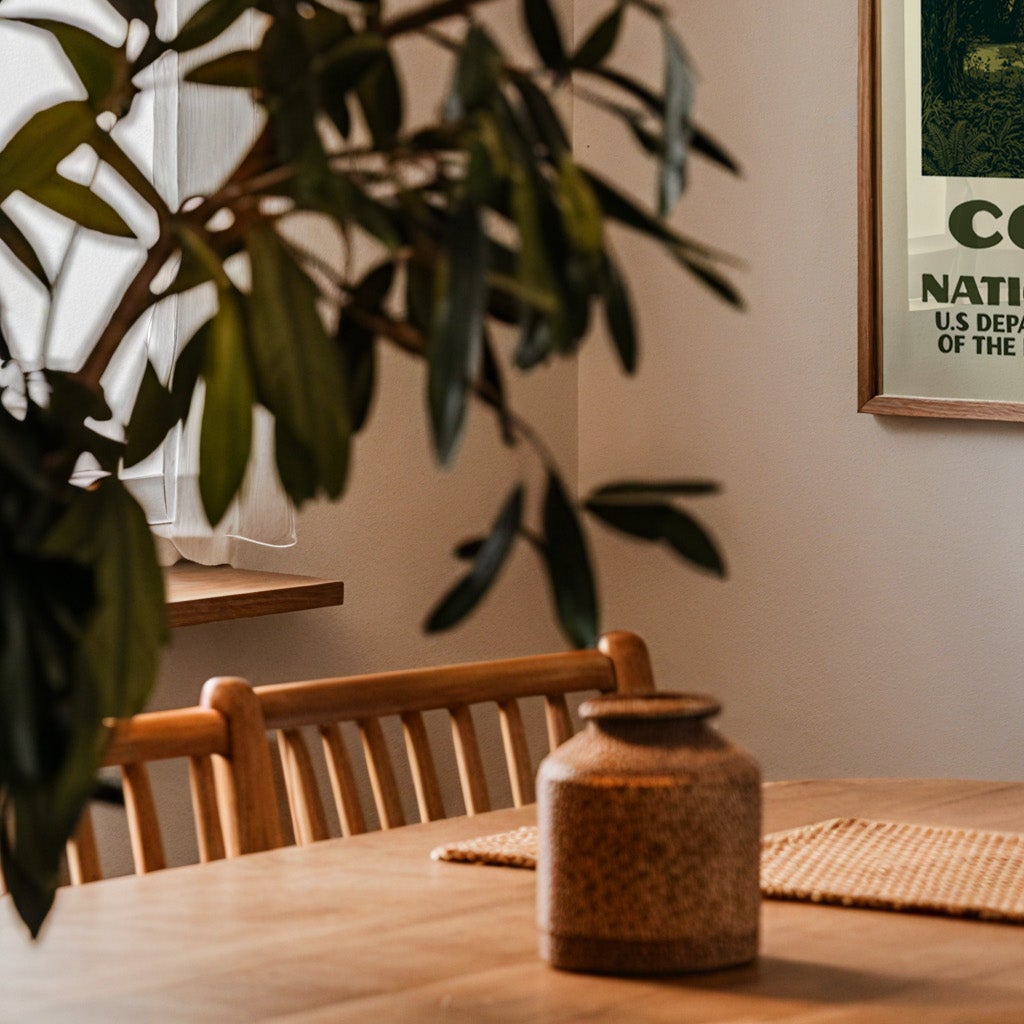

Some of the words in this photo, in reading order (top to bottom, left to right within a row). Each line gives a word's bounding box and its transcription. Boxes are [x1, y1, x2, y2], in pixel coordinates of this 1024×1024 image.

[935, 310, 970, 332] U.S
[937, 333, 966, 354] OF
[971, 335, 1017, 357] THE
